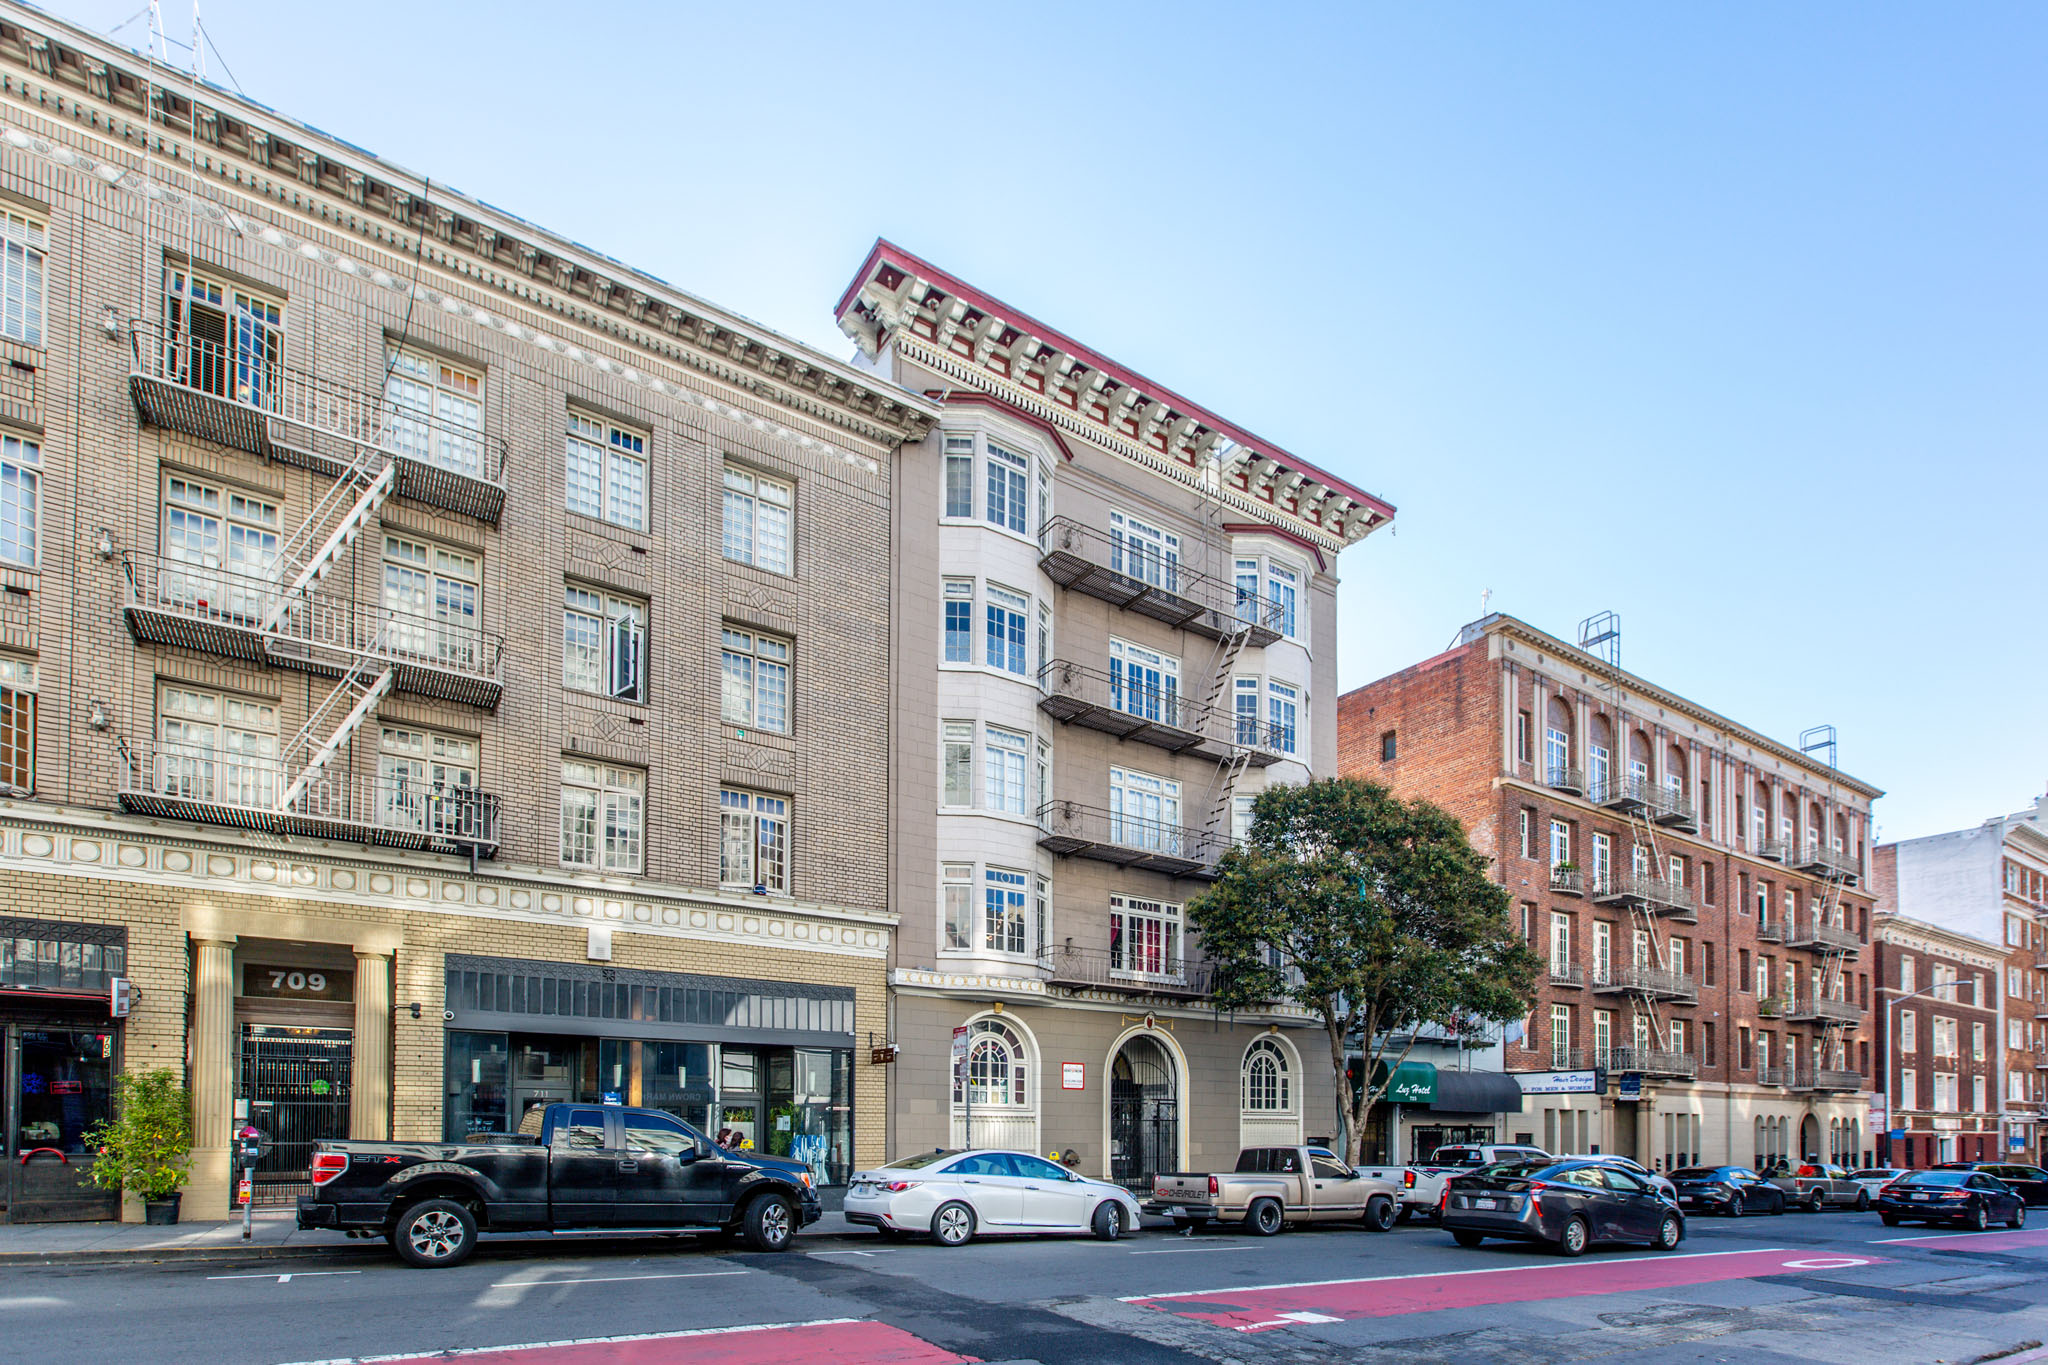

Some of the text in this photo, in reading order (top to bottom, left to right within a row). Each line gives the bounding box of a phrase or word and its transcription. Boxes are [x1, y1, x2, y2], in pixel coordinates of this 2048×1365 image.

[268, 970, 327, 992] 709
[103, 1035, 111, 1058] 705
[1569, 1074, 1593, 1084] Design
[533, 1089, 549, 1098] 711
[1395, 1082, 1410, 1097] Luz
[1410, 1083, 1432, 1095] Hotel
[353, 1154, 402, 1164] STX
[1168, 1188, 1207, 1200] CHEVROLET
